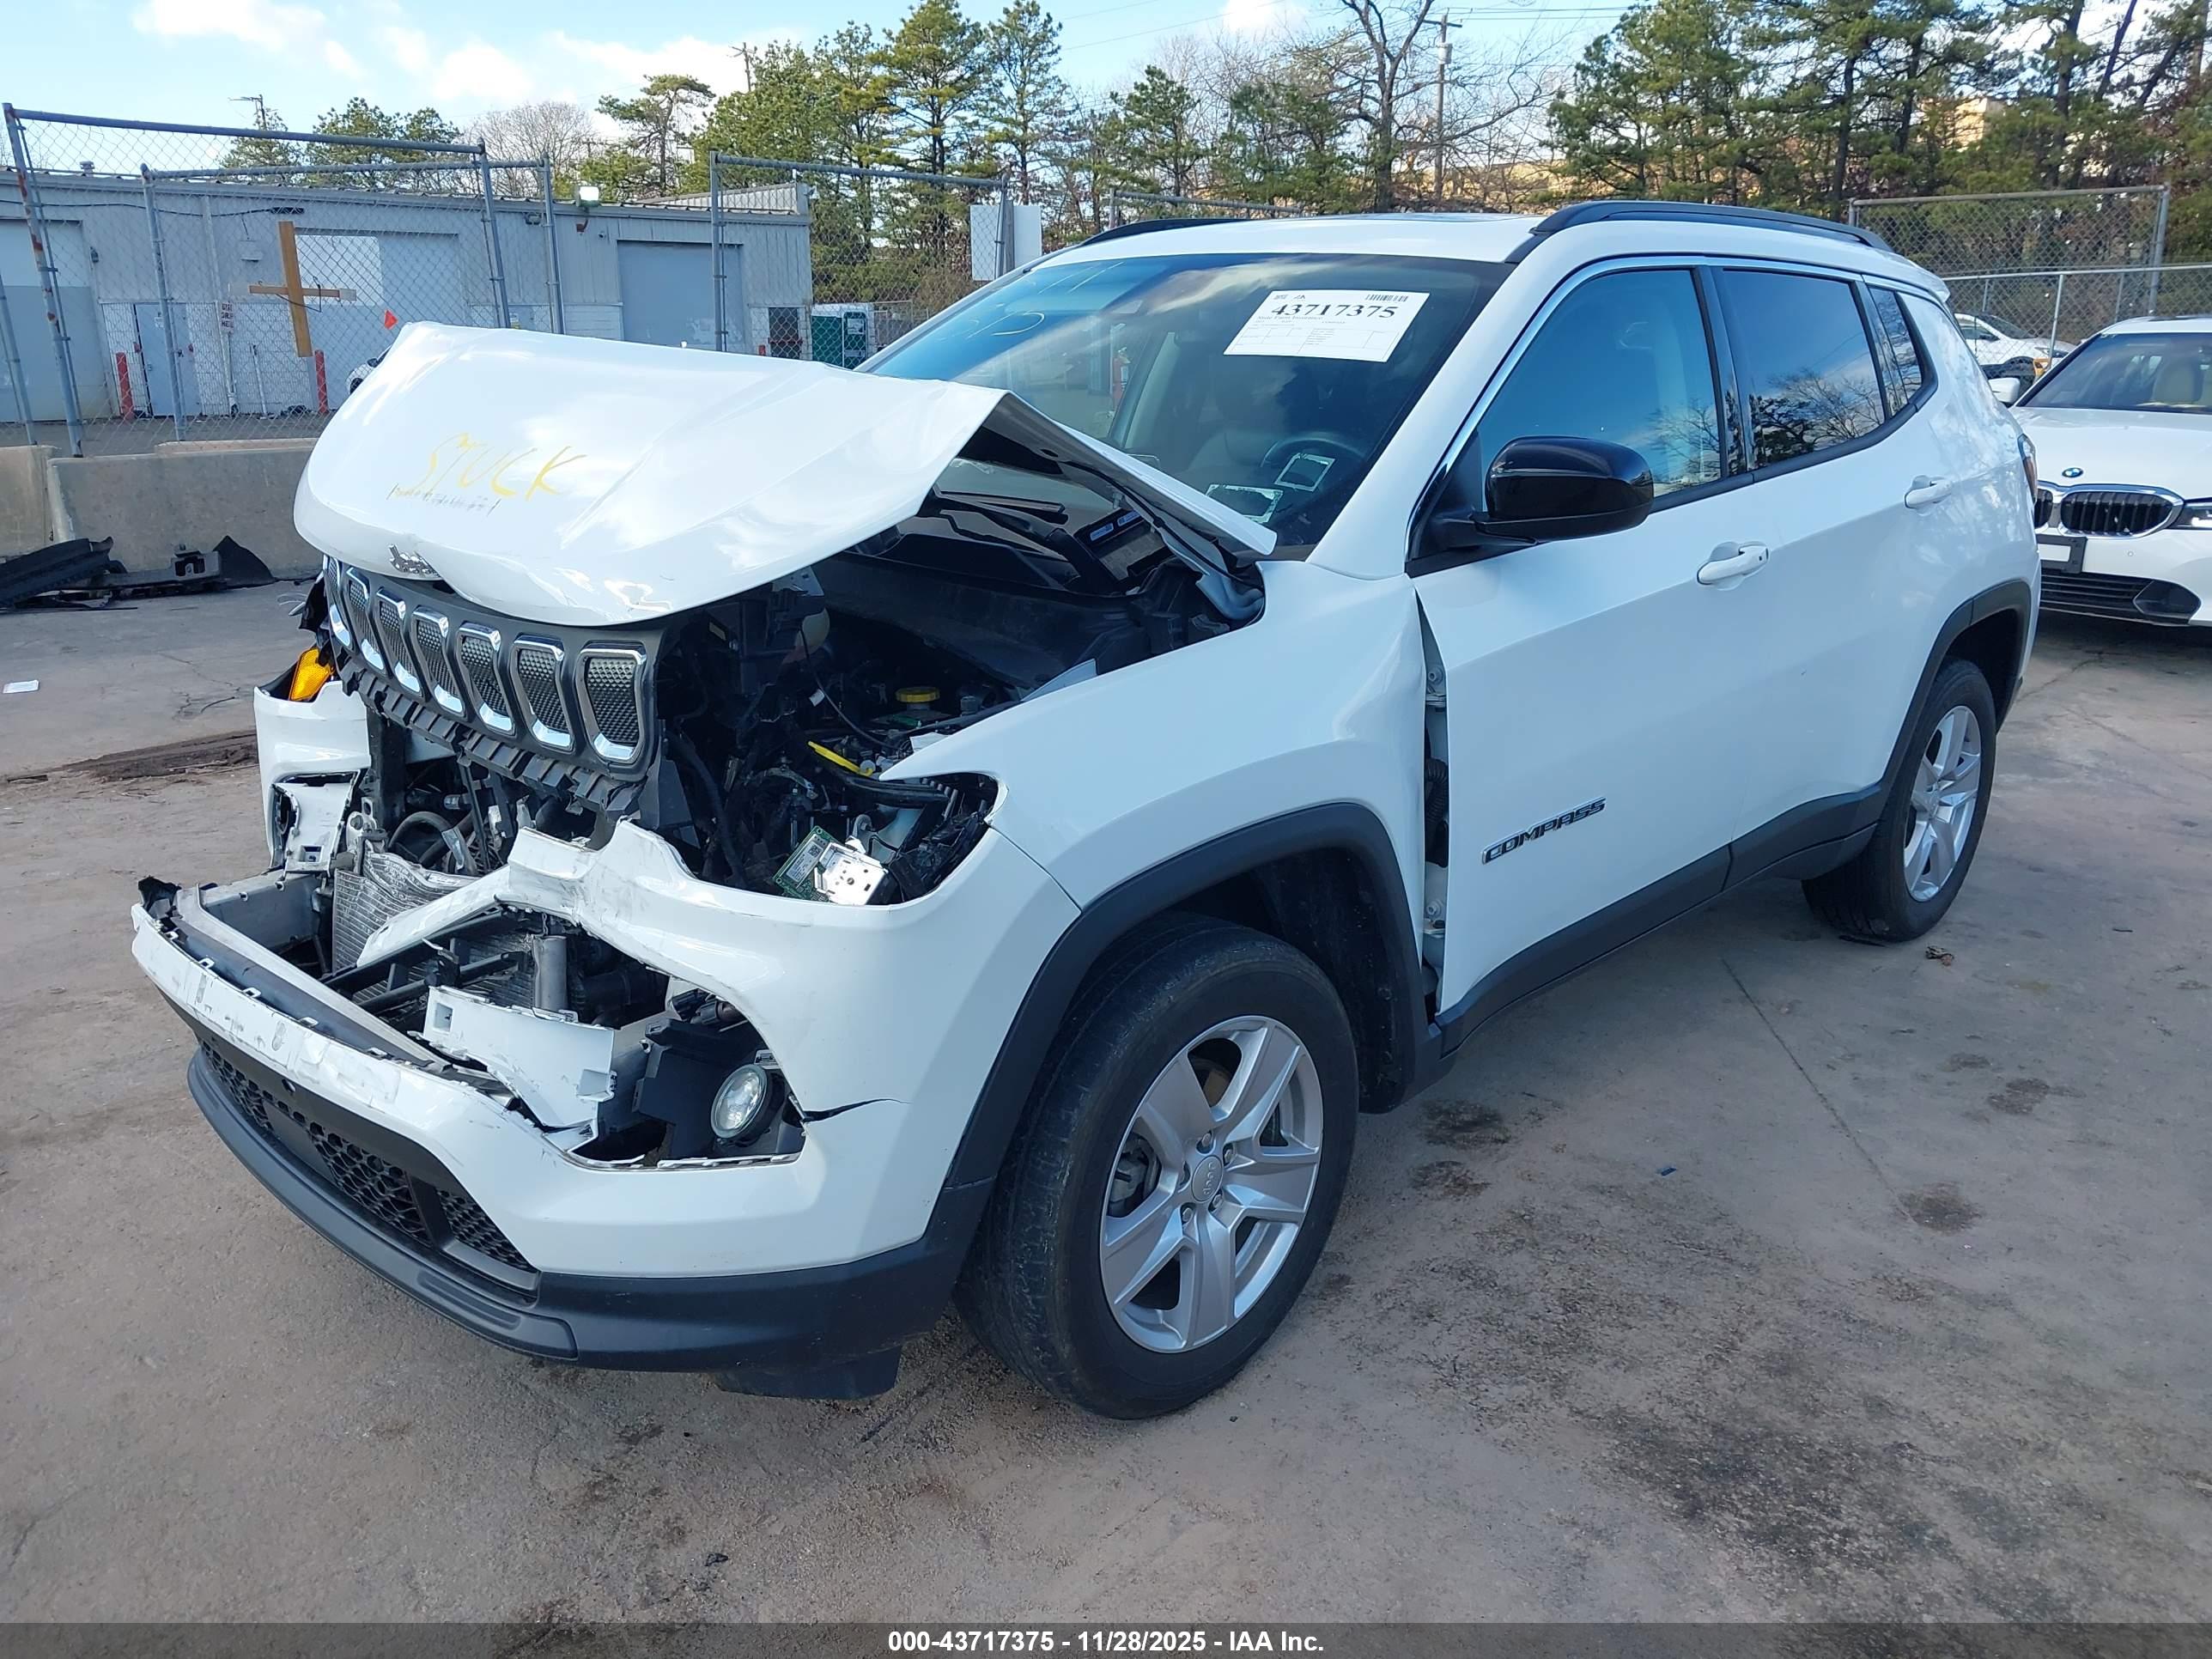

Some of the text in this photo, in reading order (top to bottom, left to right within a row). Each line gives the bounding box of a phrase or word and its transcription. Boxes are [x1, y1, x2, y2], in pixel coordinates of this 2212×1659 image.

[1271, 303, 1400, 319] 43717375
[396, 432, 588, 501] STUCK
[1481, 796, 1607, 865] COMPASS
[1202, 1159, 1217, 1195] Jeep
